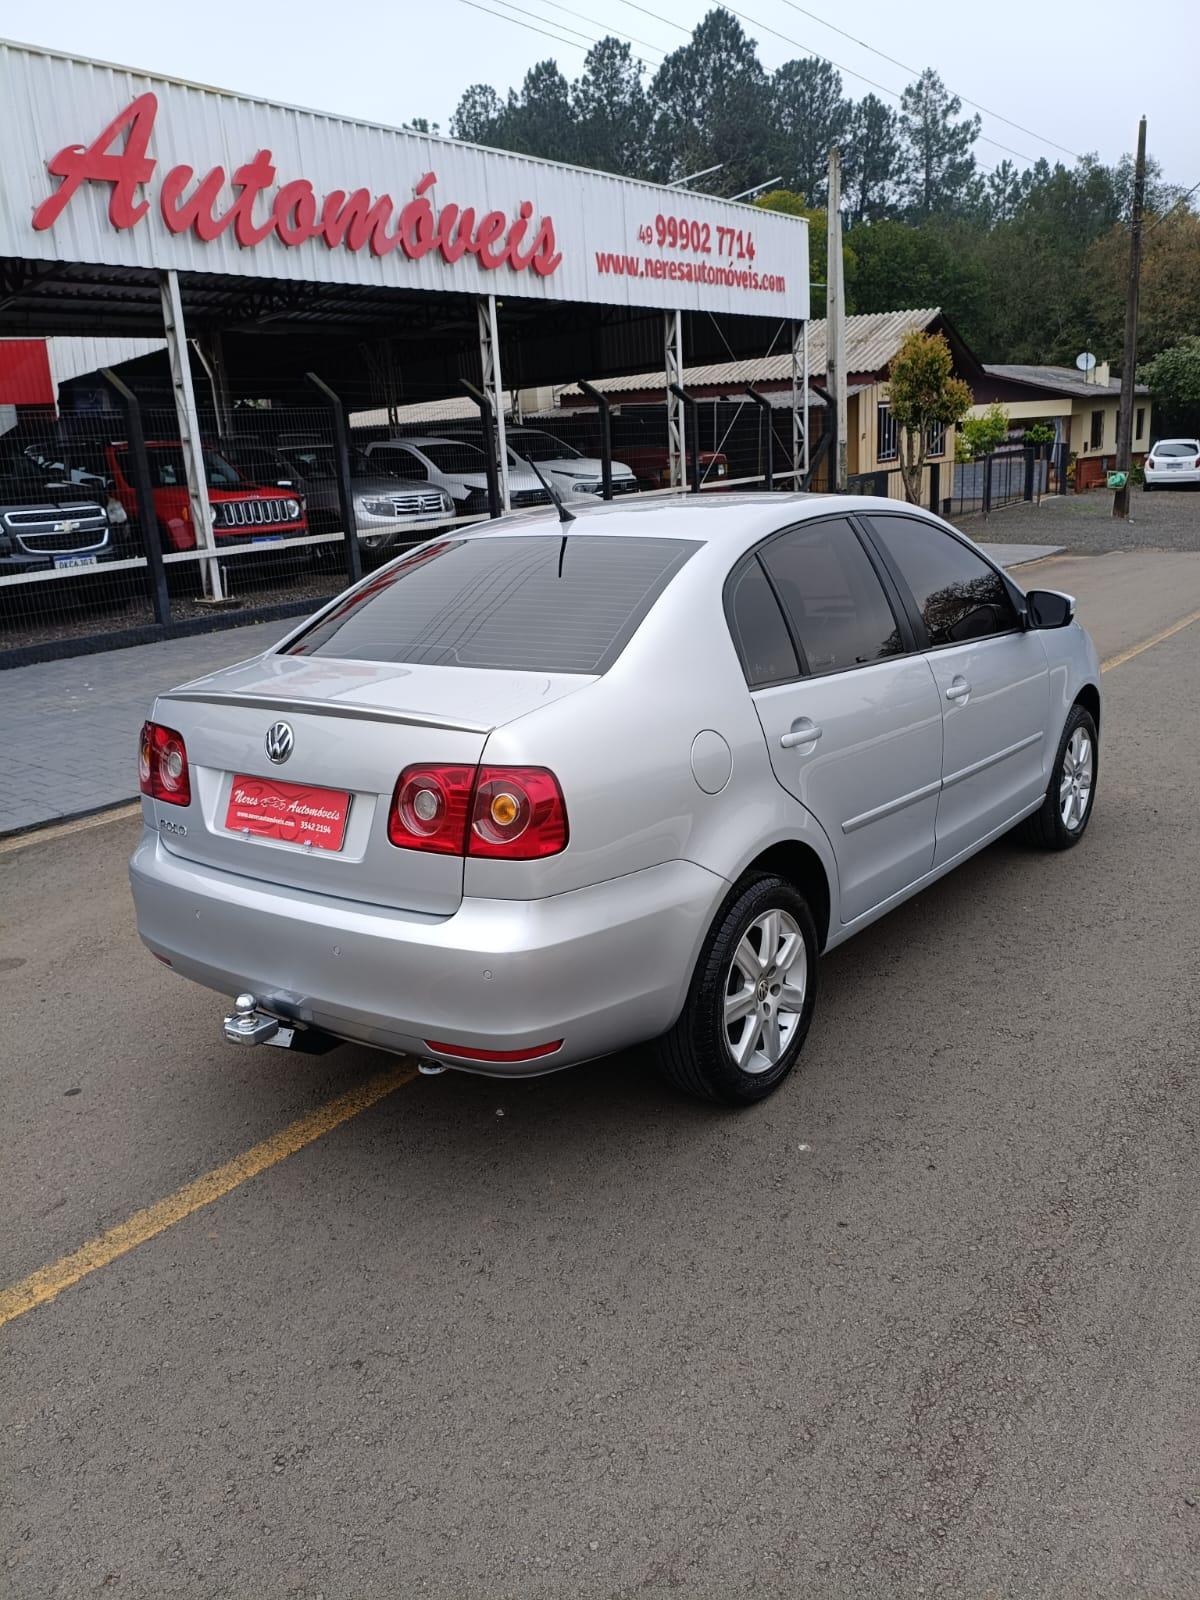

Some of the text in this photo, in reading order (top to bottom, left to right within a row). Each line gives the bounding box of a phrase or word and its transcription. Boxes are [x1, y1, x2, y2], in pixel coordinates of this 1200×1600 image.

[31, 92, 563, 277] Automóveis
[638, 214, 756, 260] 49 99902 7714
[596, 252, 786, 292] www.neresautomóveis.com
[234, 789, 340, 820] Neres Automóveis
[300, 820, 315, 831] 3542
